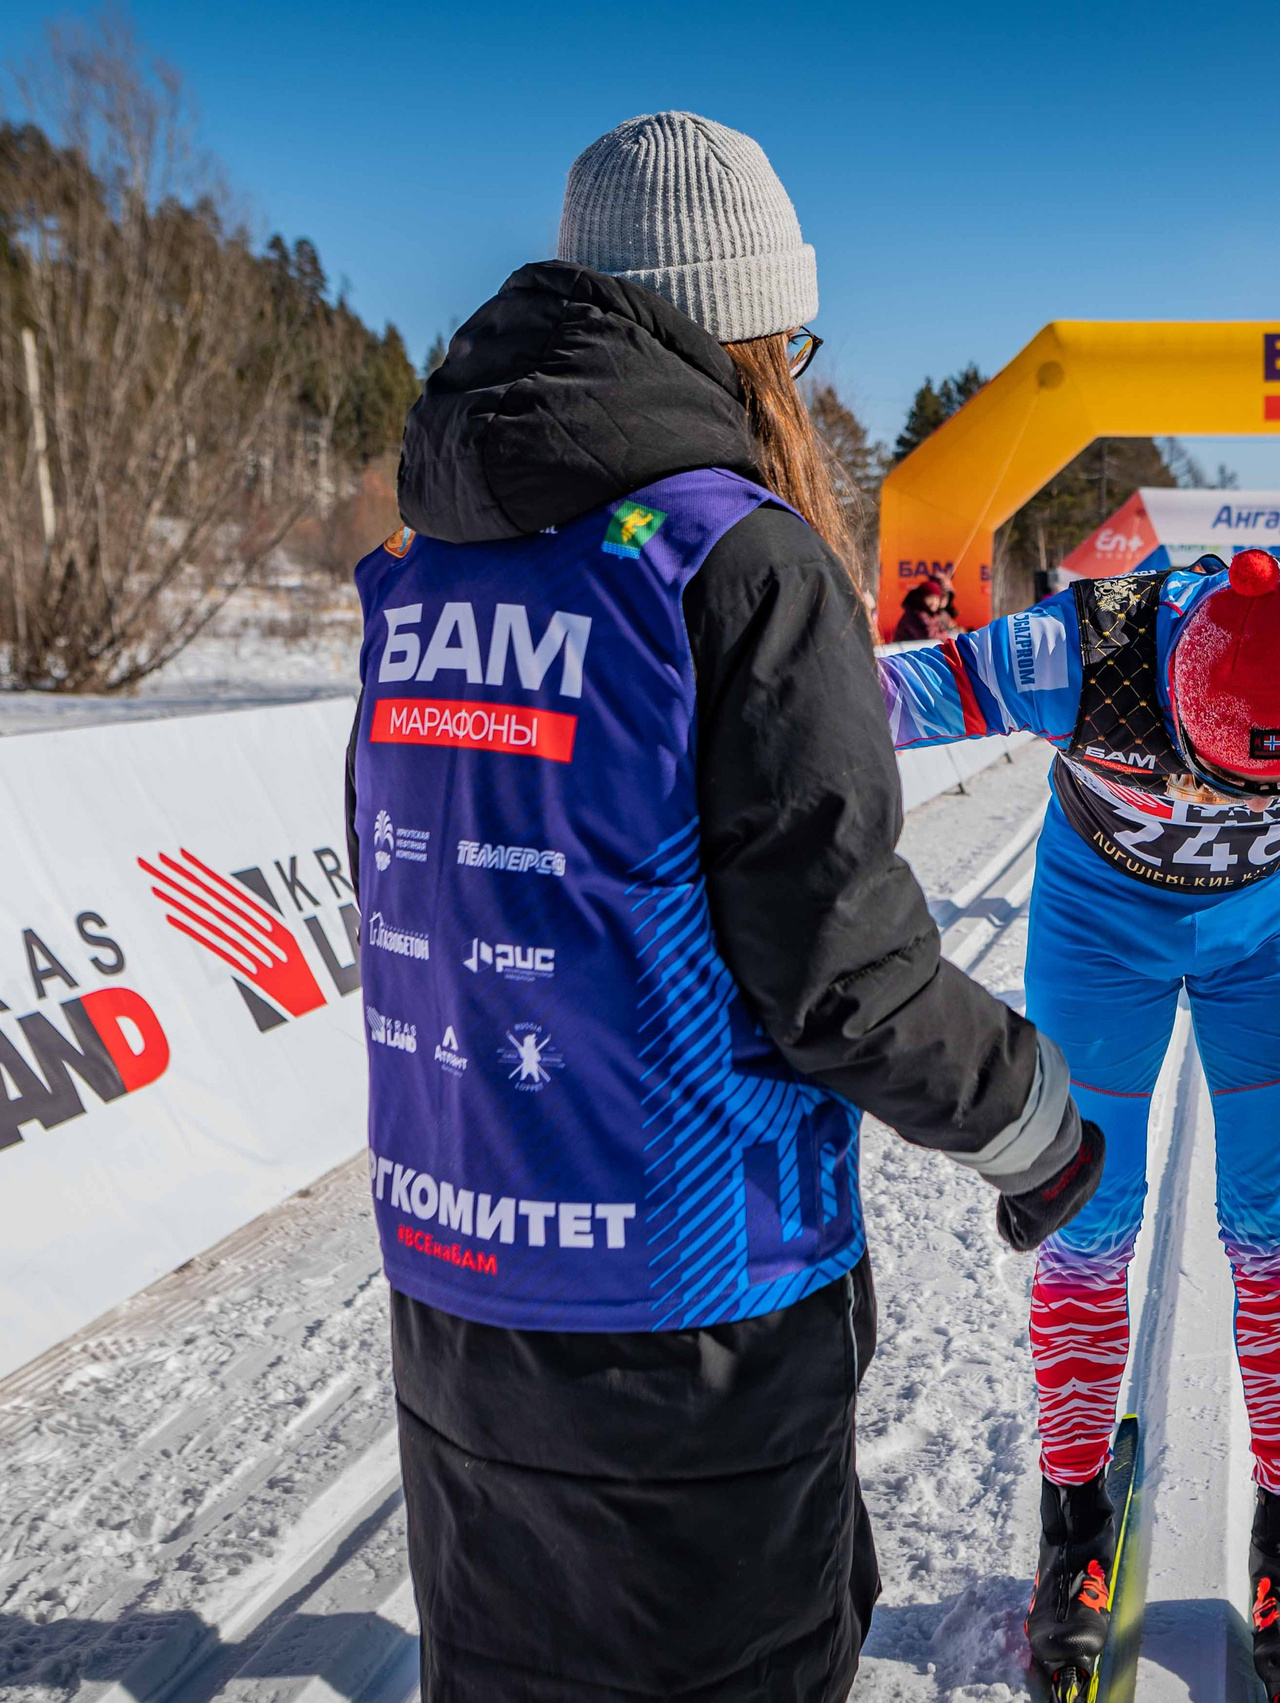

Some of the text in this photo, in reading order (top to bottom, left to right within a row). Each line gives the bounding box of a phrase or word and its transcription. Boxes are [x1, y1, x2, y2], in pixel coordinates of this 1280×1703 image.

[378, 602, 592, 699] БАМ
[1013, 621, 1035, 686] GAZPROM
[390, 707, 538, 747] МАРАФОНЫ
[1084, 745, 1156, 770] БАМ
